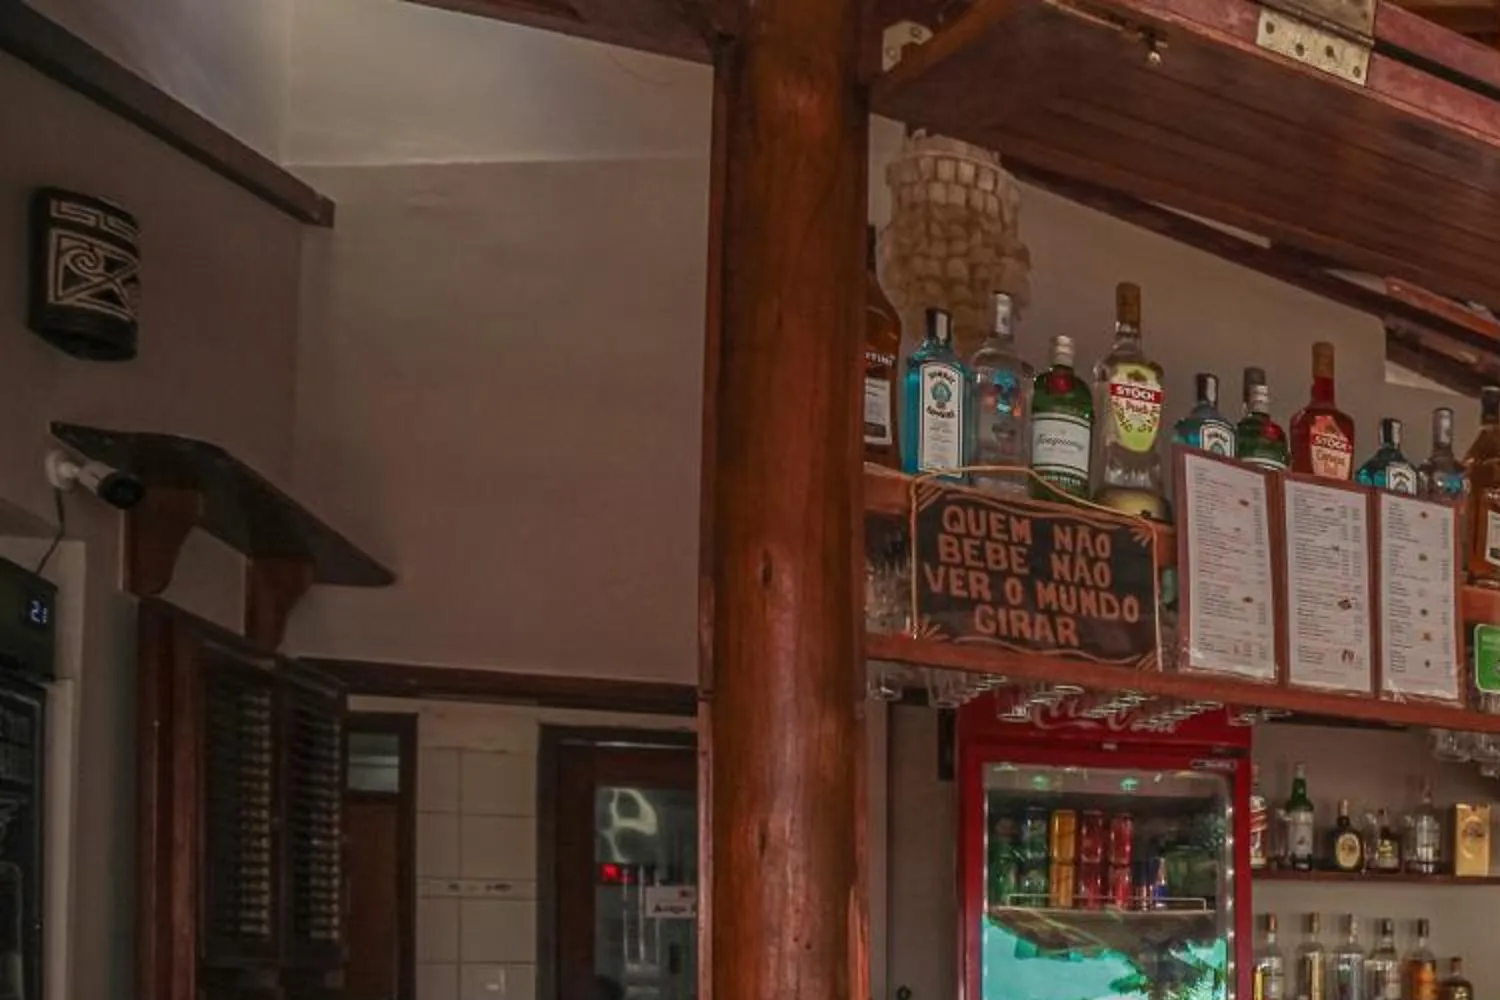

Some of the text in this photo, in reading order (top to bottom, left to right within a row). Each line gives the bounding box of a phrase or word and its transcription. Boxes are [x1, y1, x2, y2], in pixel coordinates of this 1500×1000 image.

[942, 505, 1032, 545] QUEM
[938, 533, 1030, 575] BEBE
[924, 562, 1139, 624] VER O MUNDO
[974, 603, 1079, 647] GIRAR
